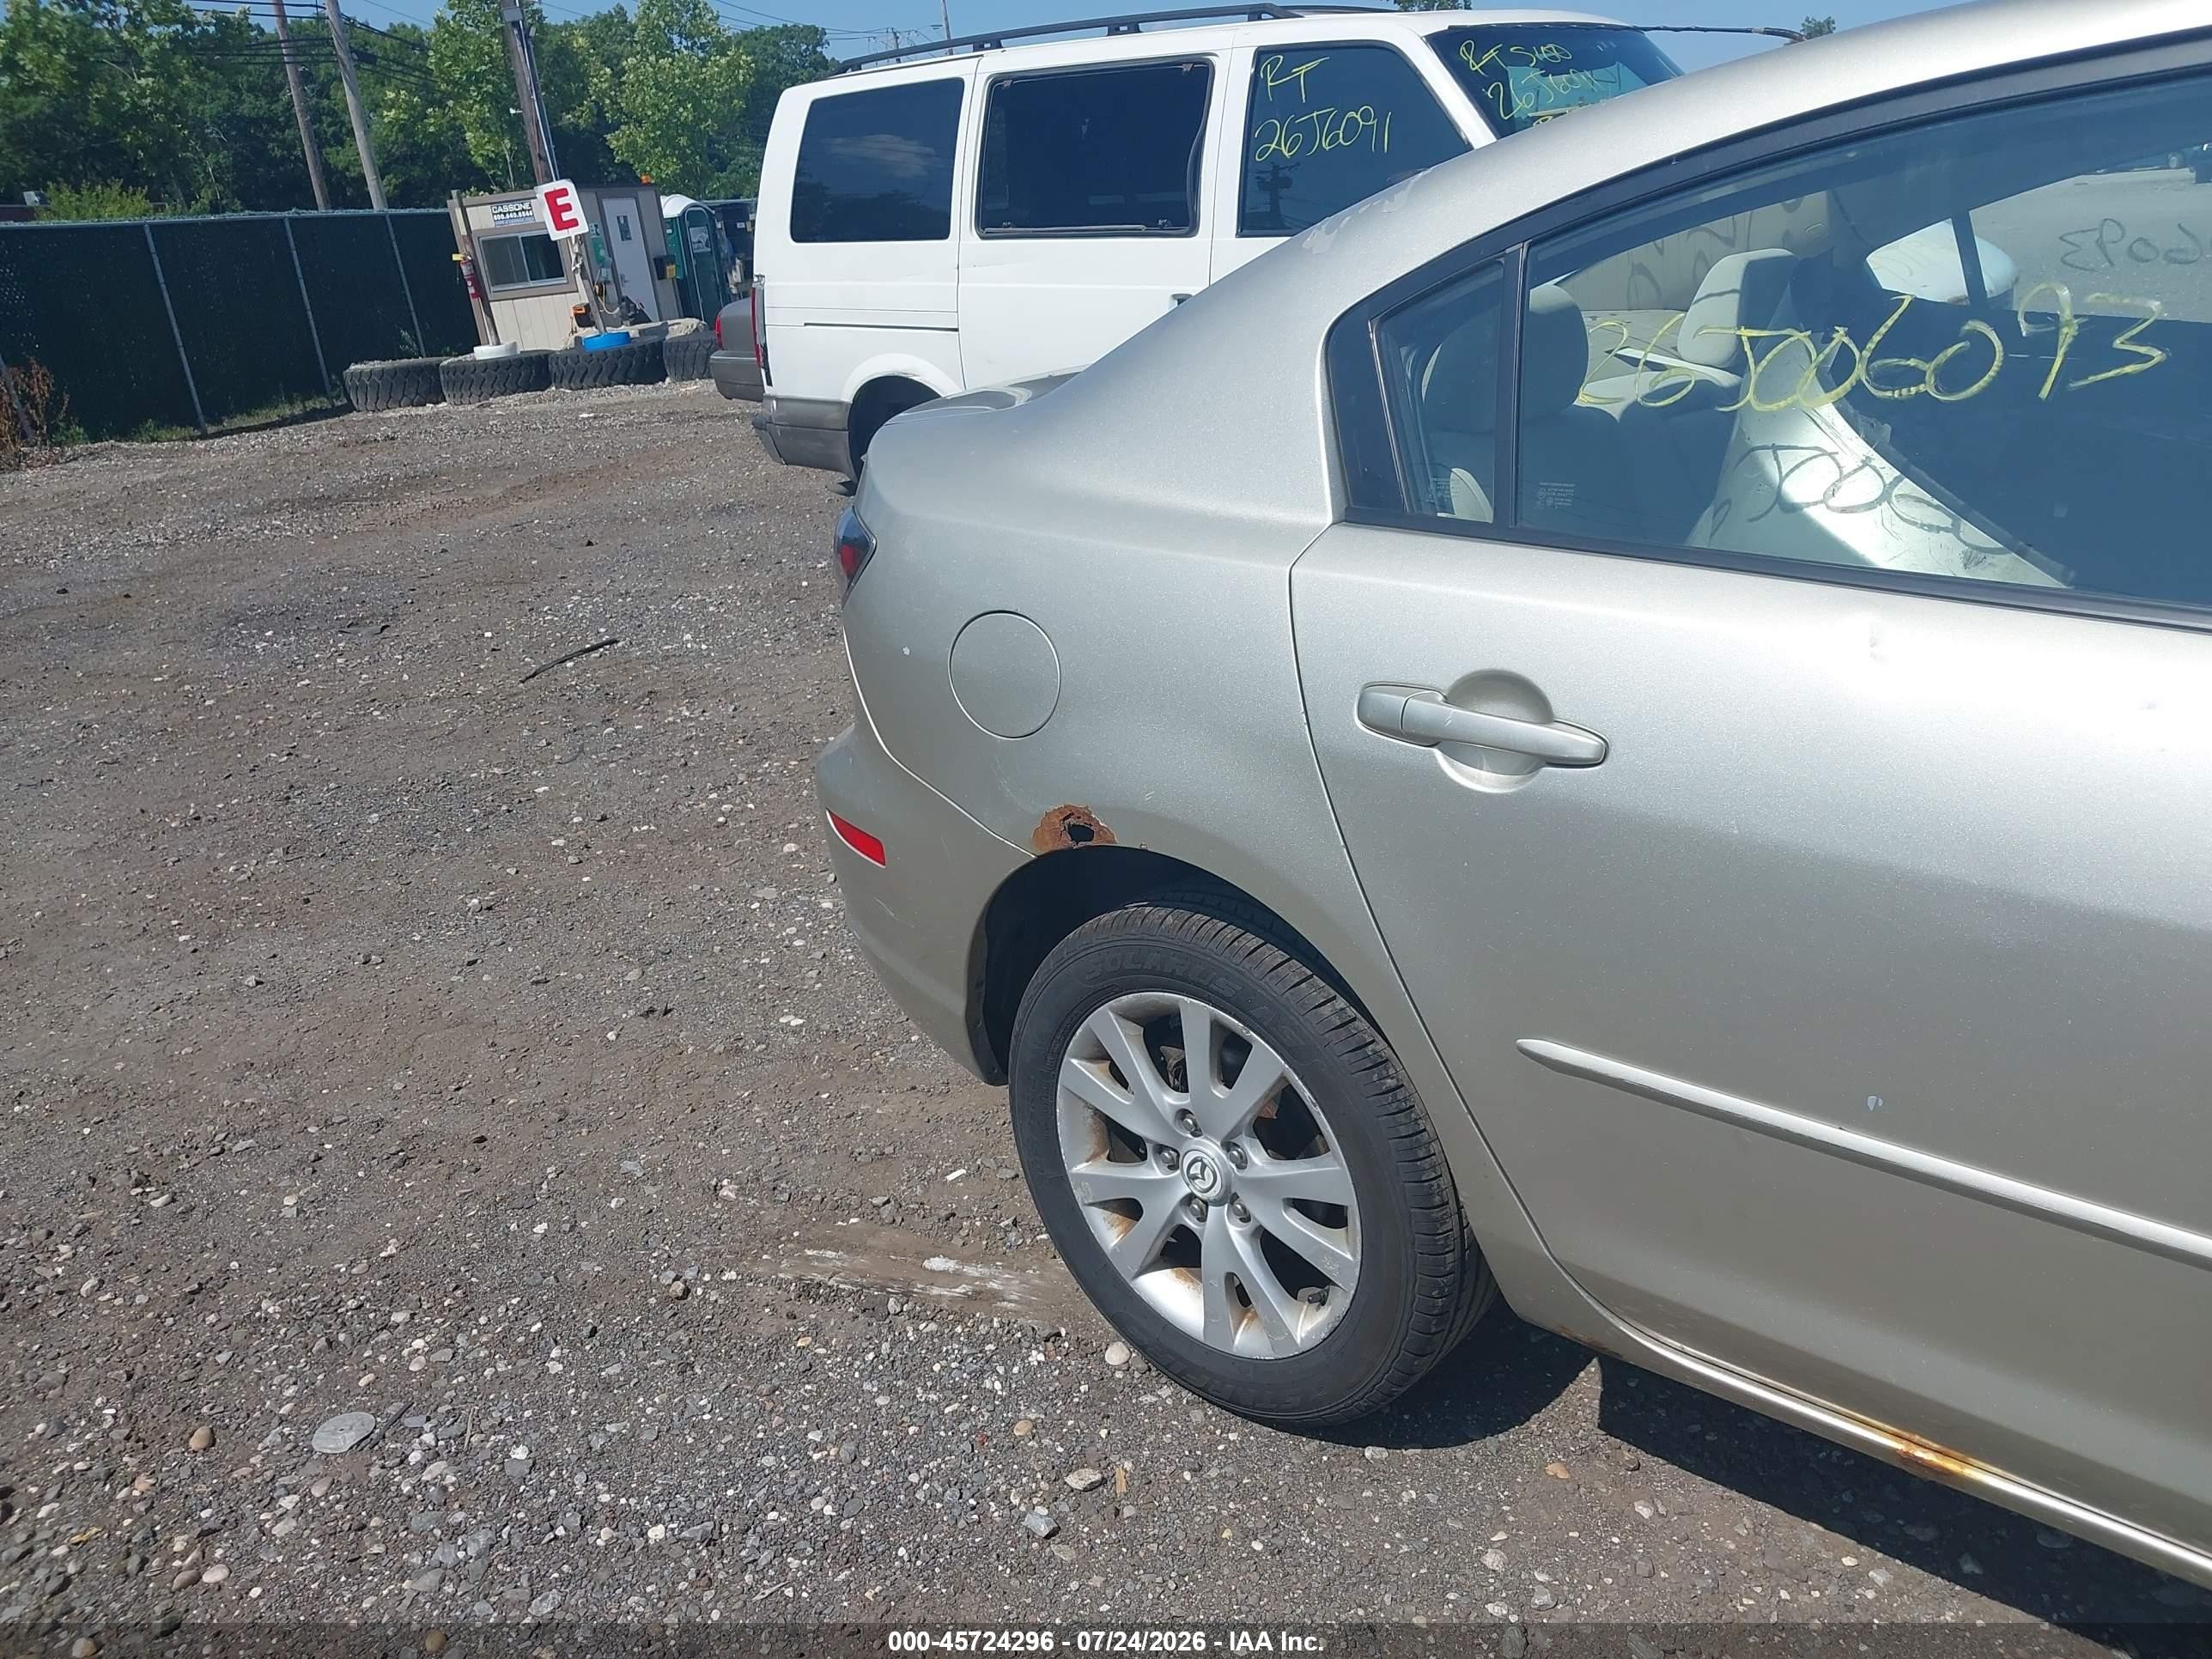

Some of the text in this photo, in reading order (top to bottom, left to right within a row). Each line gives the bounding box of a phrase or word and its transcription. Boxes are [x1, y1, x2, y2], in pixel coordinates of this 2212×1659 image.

[1260, 55, 1330, 103] RT
[1255, 105, 1391, 161] 26J6091
[492, 202, 532, 214] CASSONE
[544, 187, 580, 232] E
[1085, 950, 1243, 998] SOLARUS
